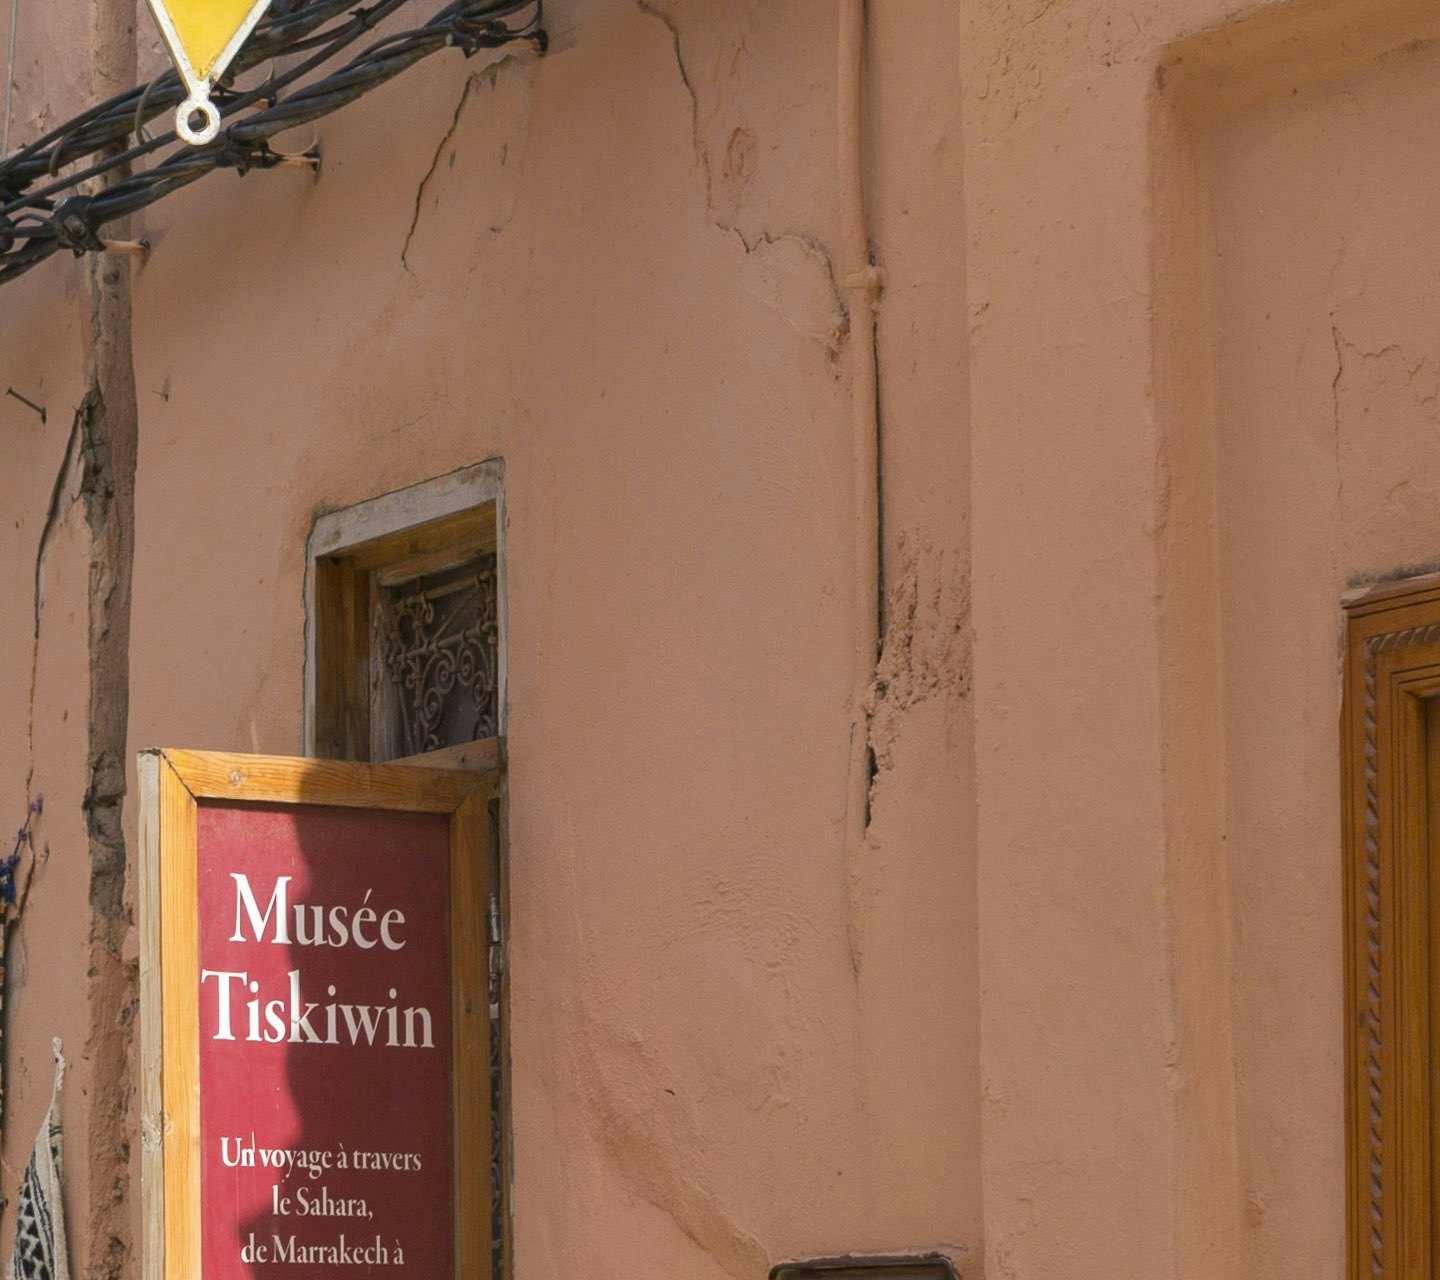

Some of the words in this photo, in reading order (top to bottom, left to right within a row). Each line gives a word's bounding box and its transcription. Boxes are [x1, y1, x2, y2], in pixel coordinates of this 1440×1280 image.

[228, 872, 407, 951] Musée
[201, 969, 436, 1049] Tiskiwin
[220, 1136, 256, 1168] Un
[259, 1147, 333, 1180] voyage
[336, 1141, 349, 1169] à
[353, 1148, 422, 1172] travers
[272, 1184, 291, 1216] le
[296, 1185, 374, 1220] Sahara,
[240, 1232, 268, 1265] de
[271, 1233, 389, 1266] Marrakech
[392, 1238, 406, 1266] à
